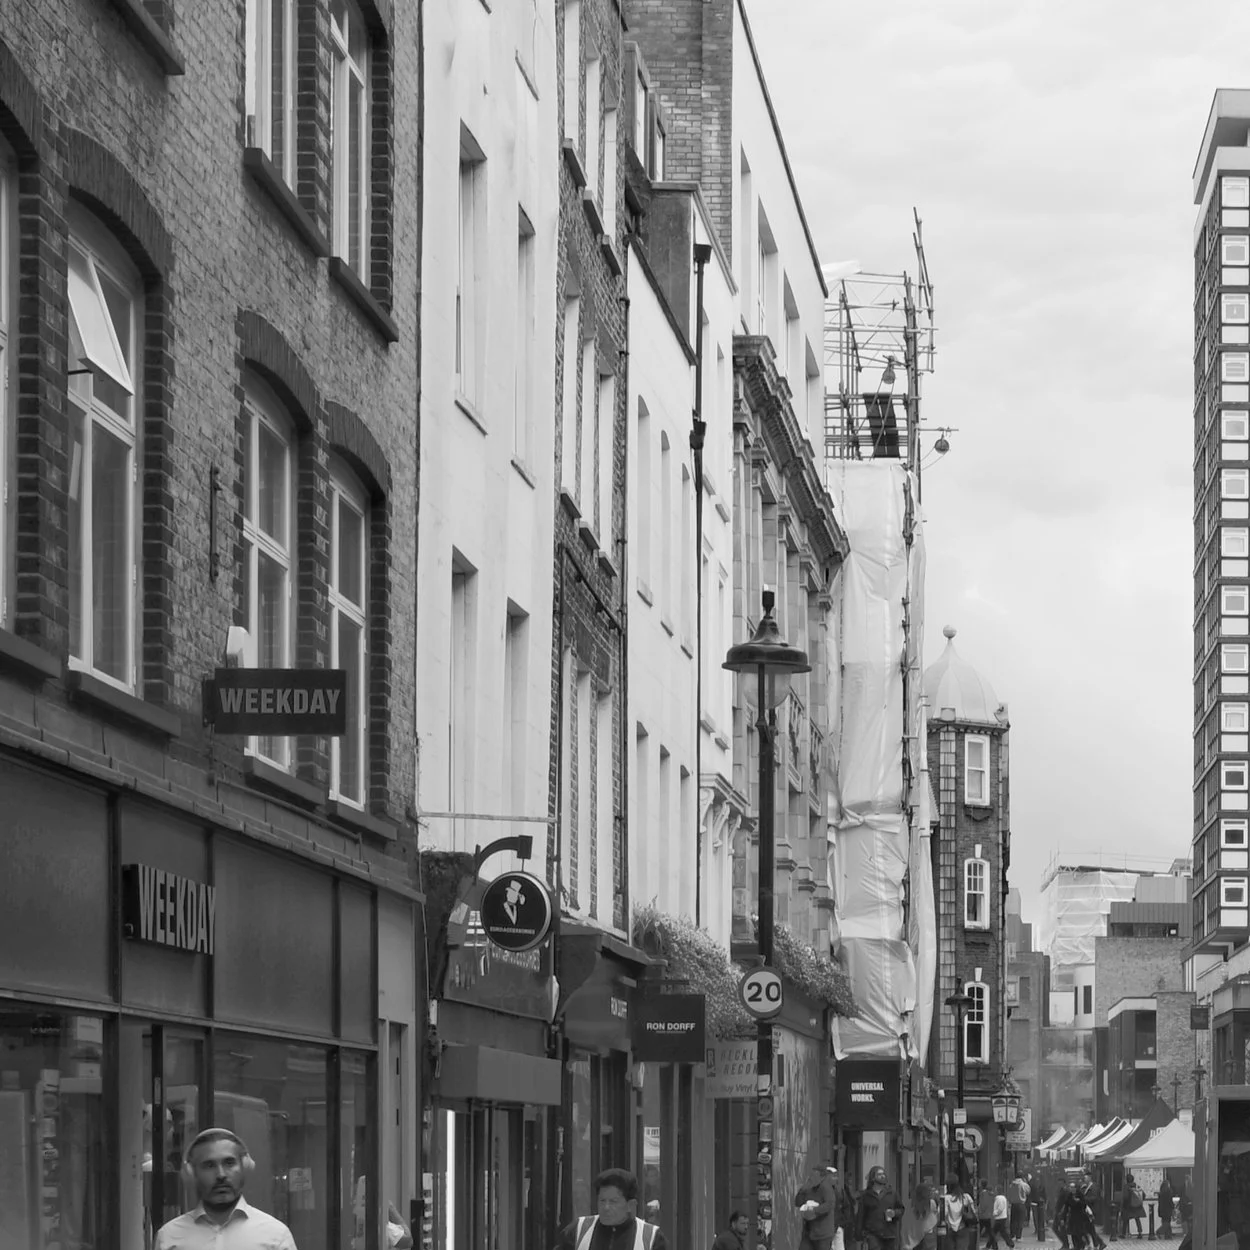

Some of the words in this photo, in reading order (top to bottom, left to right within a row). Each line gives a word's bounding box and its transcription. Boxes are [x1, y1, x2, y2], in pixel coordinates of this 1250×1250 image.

[220, 689, 341, 714] WEEKDAY
[138, 864, 216, 955] WEEKDAY
[747, 981, 781, 1002] 20
[646, 1022, 666, 1031] RON
[667, 1022, 696, 1031] DORFF
[720, 1047, 756, 1062] RECKL
[851, 1082, 884, 1091] UNIVERSAL
